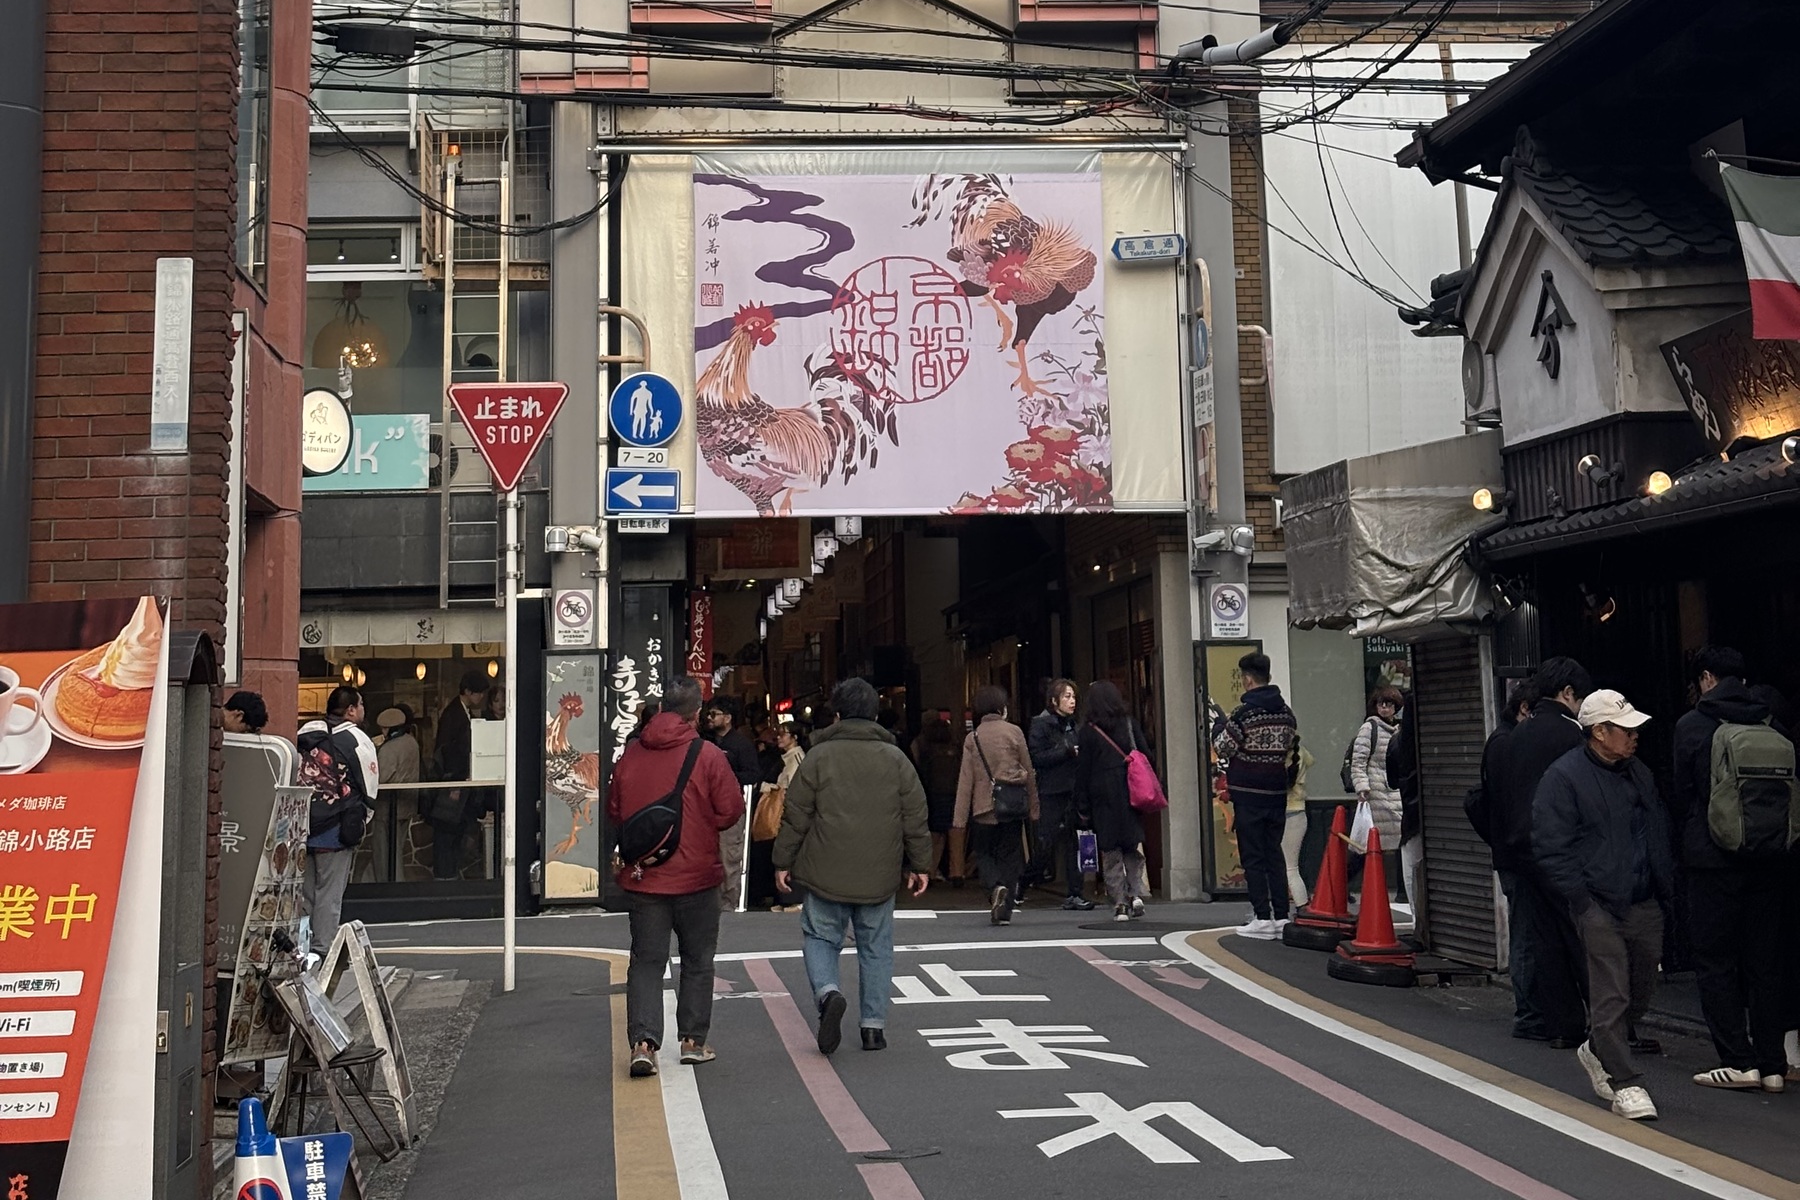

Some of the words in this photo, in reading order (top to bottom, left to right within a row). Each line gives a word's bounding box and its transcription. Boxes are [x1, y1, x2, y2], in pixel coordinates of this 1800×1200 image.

[1124, 237, 1174, 251] 高倉通
[1129, 248, 1171, 257] Takakura-dori
[473, 396, 545, 420] 止まれ
[485, 425, 535, 445] STOP
[620, 519, 668, 529] 自転車を除く
[1366, 644, 1405, 654] Sukiyaki
[645, 637, 664, 698] おかき処
[608, 654, 646, 786] 寺子屋
[0, 826, 97, 854] 錦小路店
[217, 821, 247, 853] 景
[890, 963, 1295, 1164] 止まれ
[0, 1101, 51, 1115] ンセント)
[304, 1140, 327, 1200] 駐車禁
